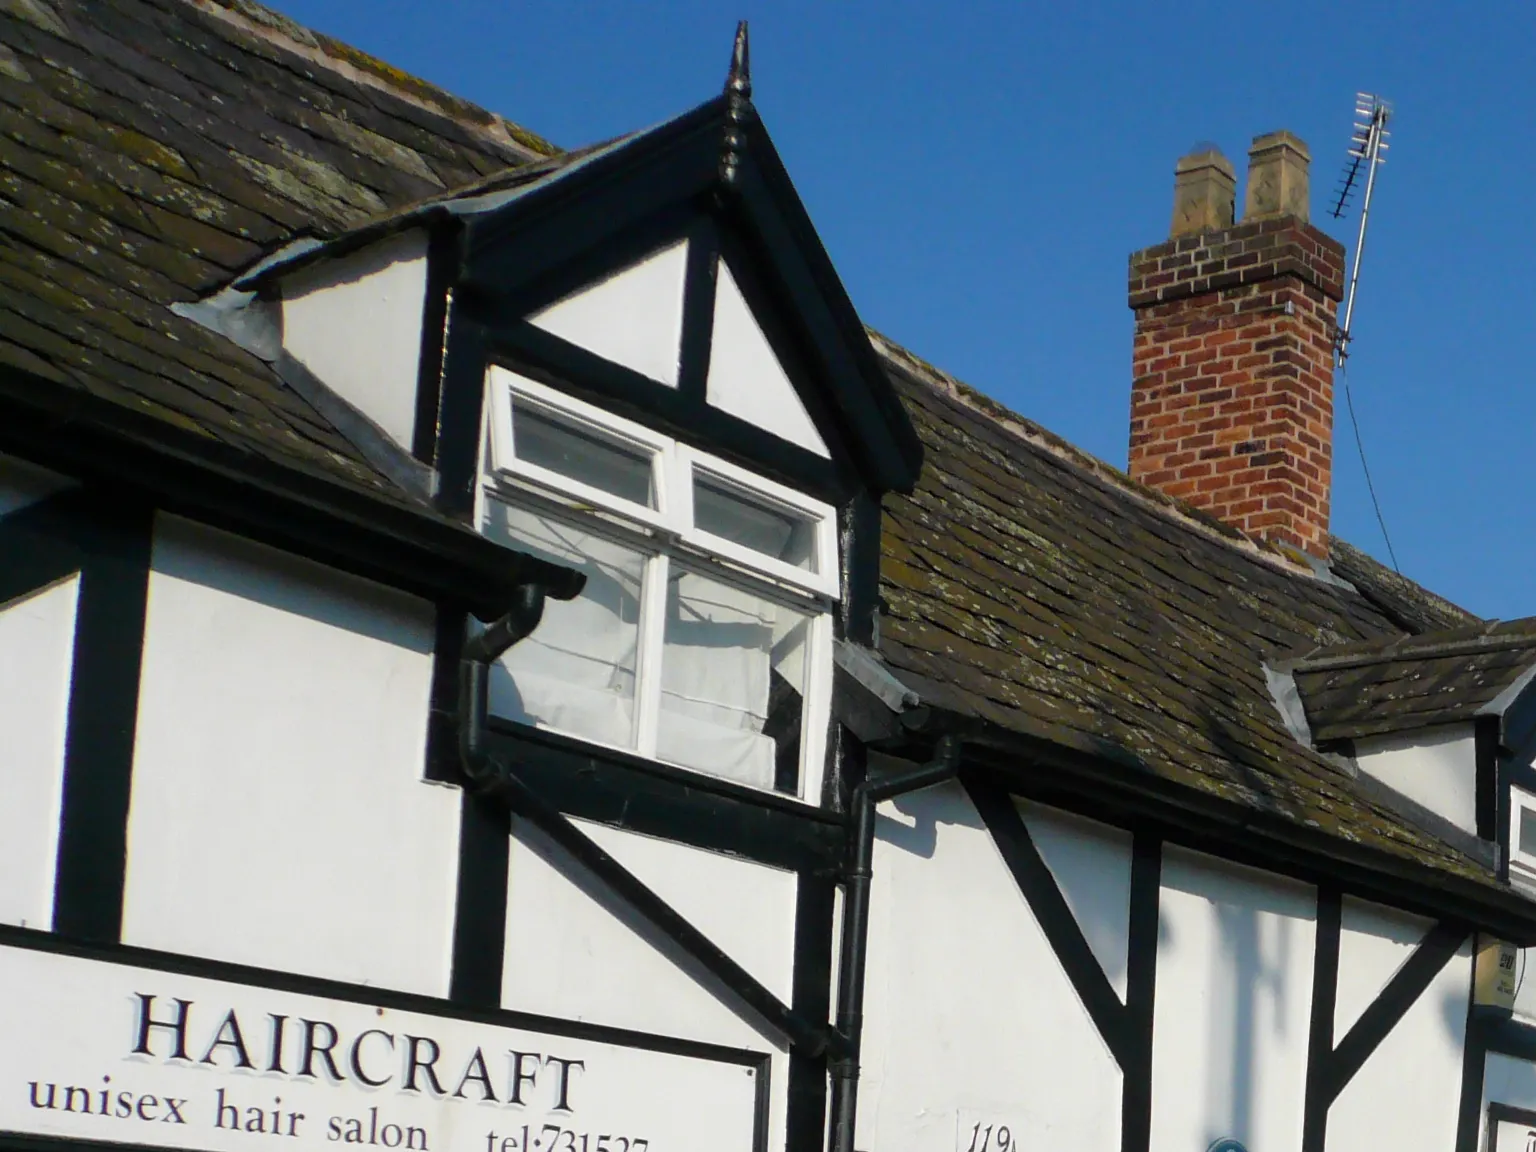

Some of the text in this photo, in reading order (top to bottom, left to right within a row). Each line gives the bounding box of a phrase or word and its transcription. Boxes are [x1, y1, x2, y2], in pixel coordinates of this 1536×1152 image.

[129, 991, 586, 1113] HAIRCRAFT
[27, 1074, 188, 1125] unisex
[213, 1087, 305, 1138] hair
[326, 1106, 429, 1152] salon
